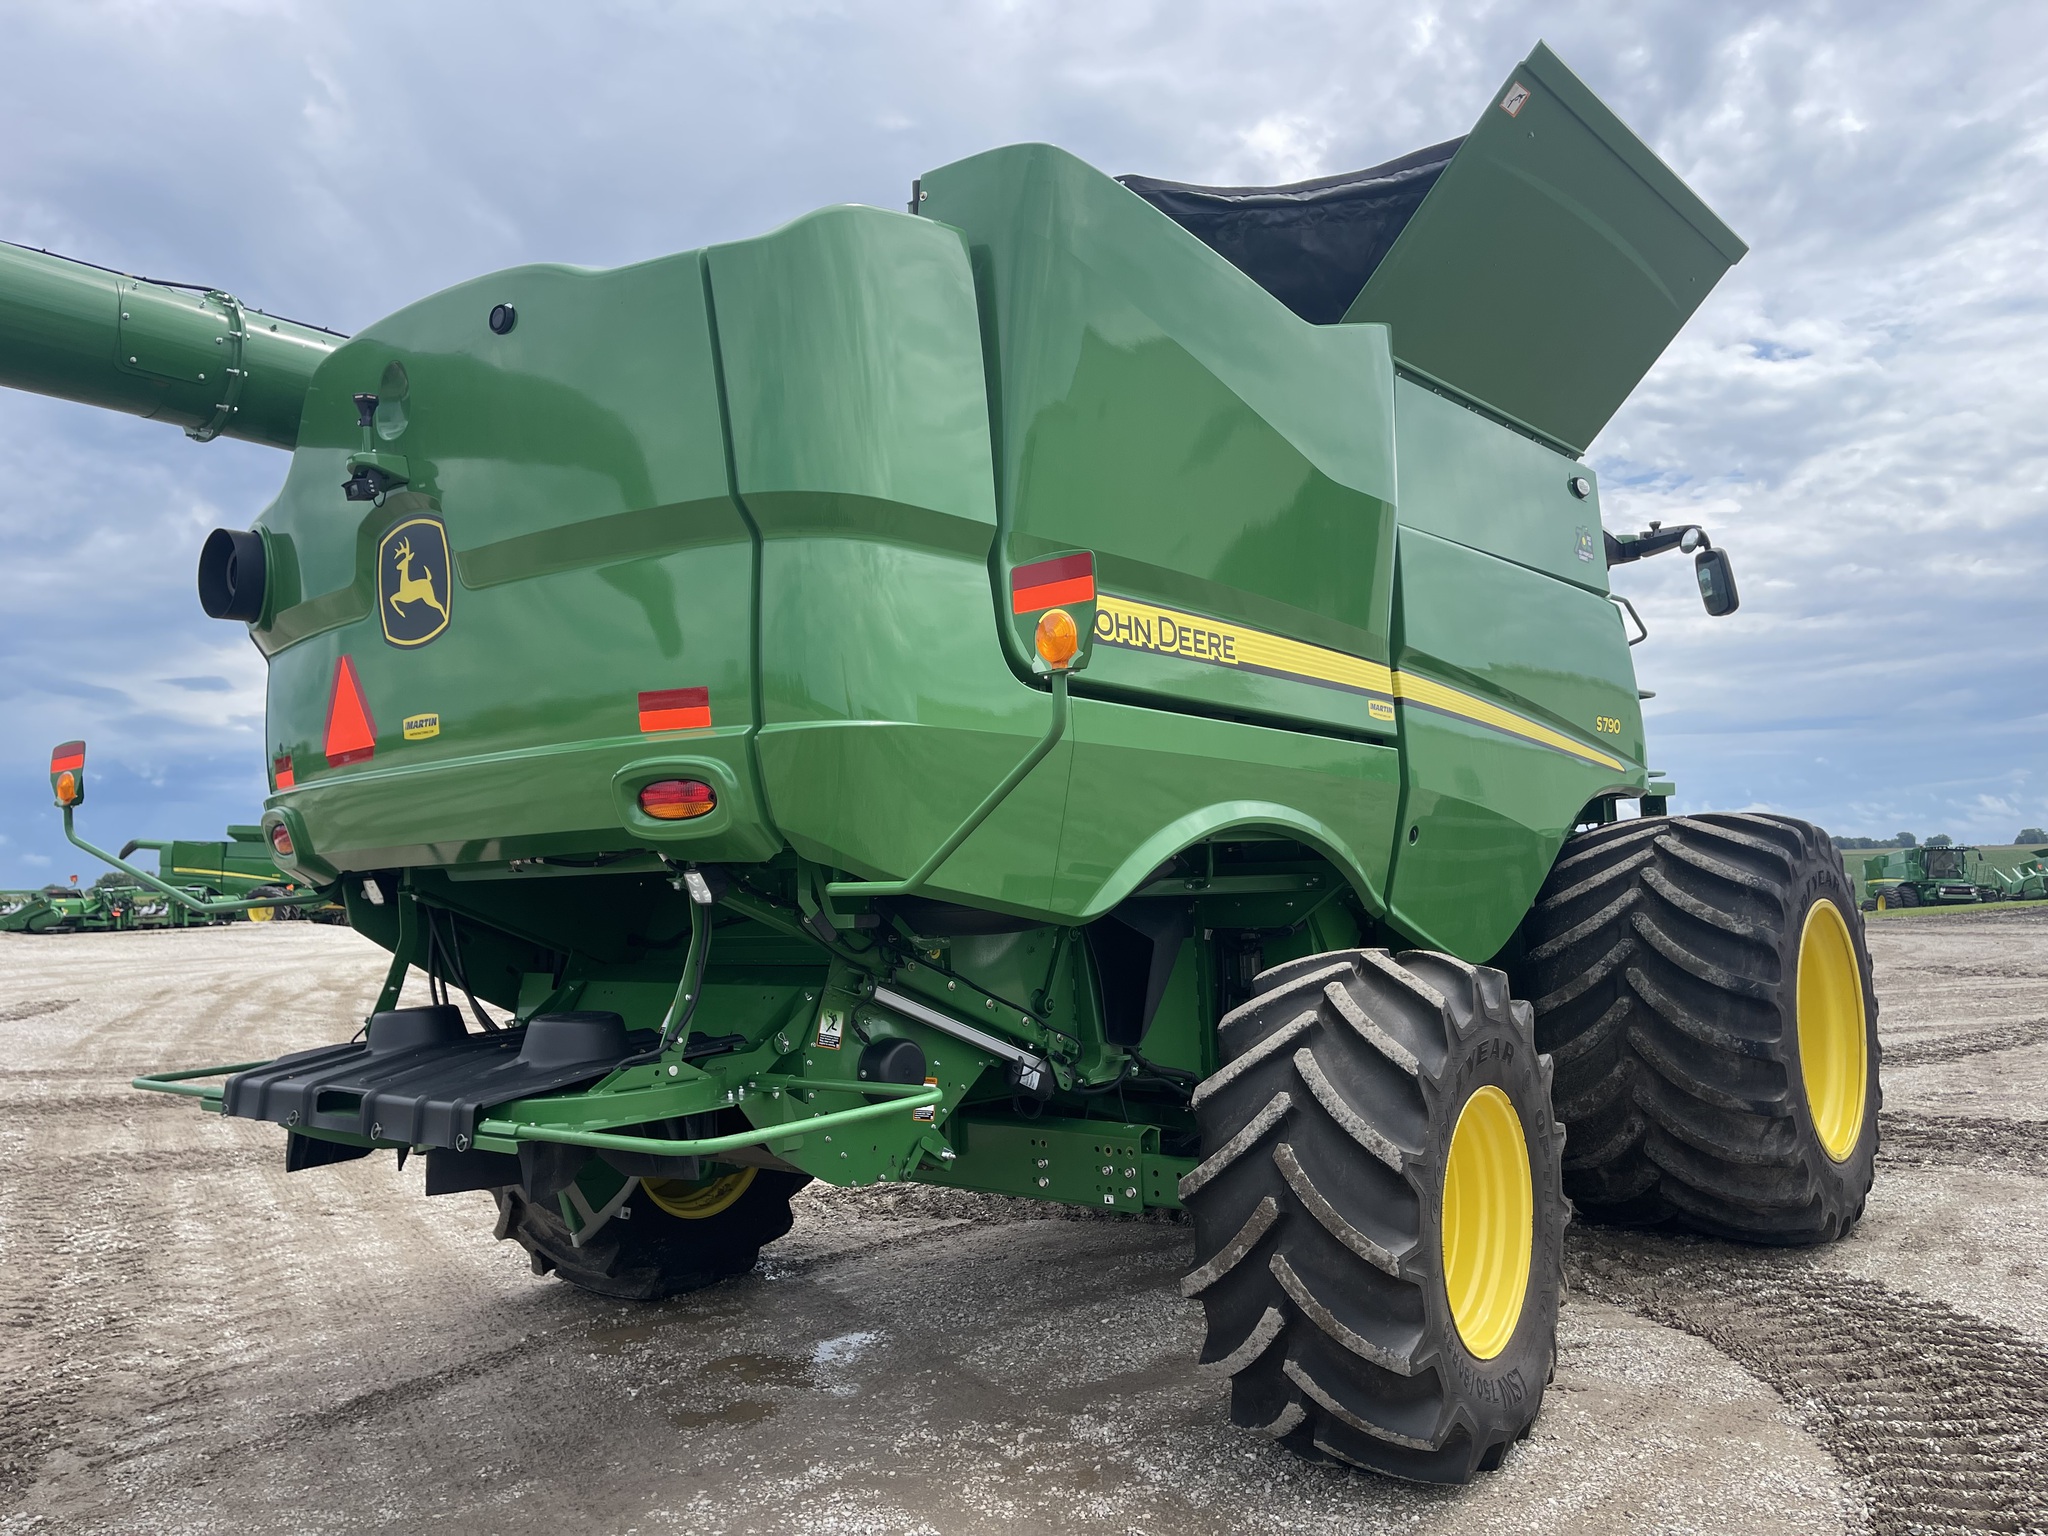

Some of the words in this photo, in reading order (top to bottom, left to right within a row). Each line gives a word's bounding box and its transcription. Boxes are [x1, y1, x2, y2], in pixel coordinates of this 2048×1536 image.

[1095, 609, 1152, 645] OHN
[1158, 615, 1236, 660] DEERE
[1370, 703, 1393, 714] MARTIN
[405, 717, 437, 730] MARTIN
[1596, 715, 1621, 735] S790
